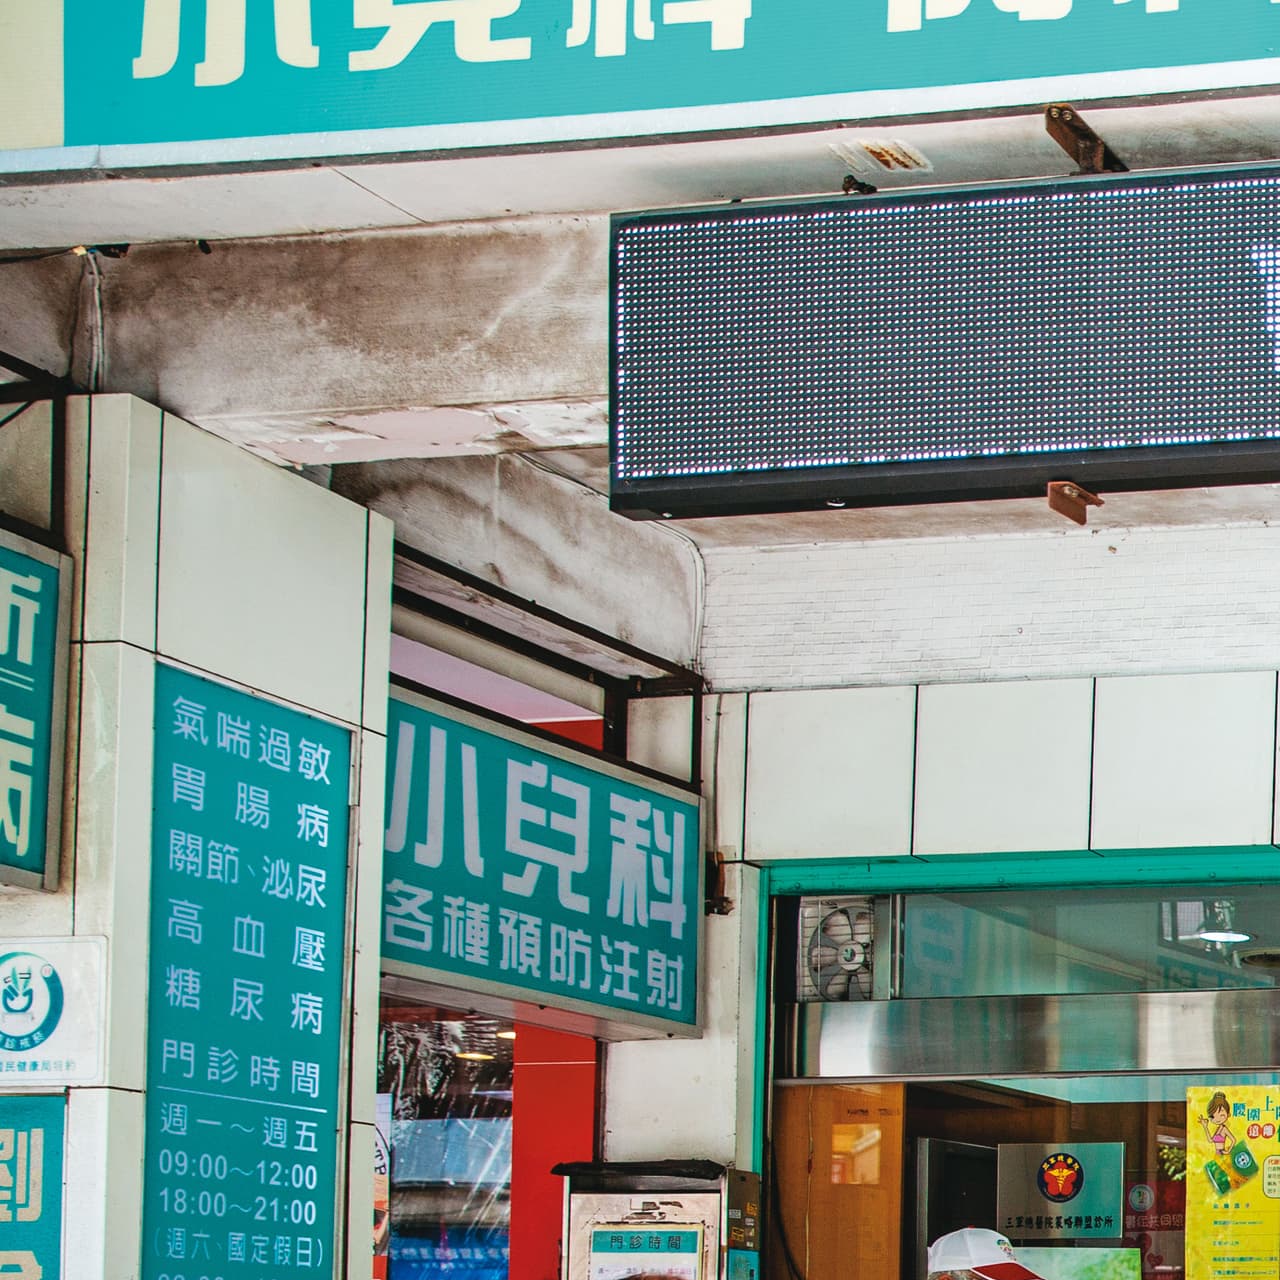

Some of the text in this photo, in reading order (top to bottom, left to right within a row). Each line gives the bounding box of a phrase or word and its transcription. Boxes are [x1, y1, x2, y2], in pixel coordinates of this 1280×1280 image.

[170, 695, 331, 786] 氣喘過敏
[171, 762, 329, 848] 胃腸病
[384, 720, 687, 940] 小兒科
[167, 898, 326, 973] 高血壓
[385, 878, 684, 1012] 各種預防注射
[165, 965, 323, 1036] 糖尿病
[161, 1039, 321, 1099] 門診時間
[610, 1235, 682, 1250] 門診時間
